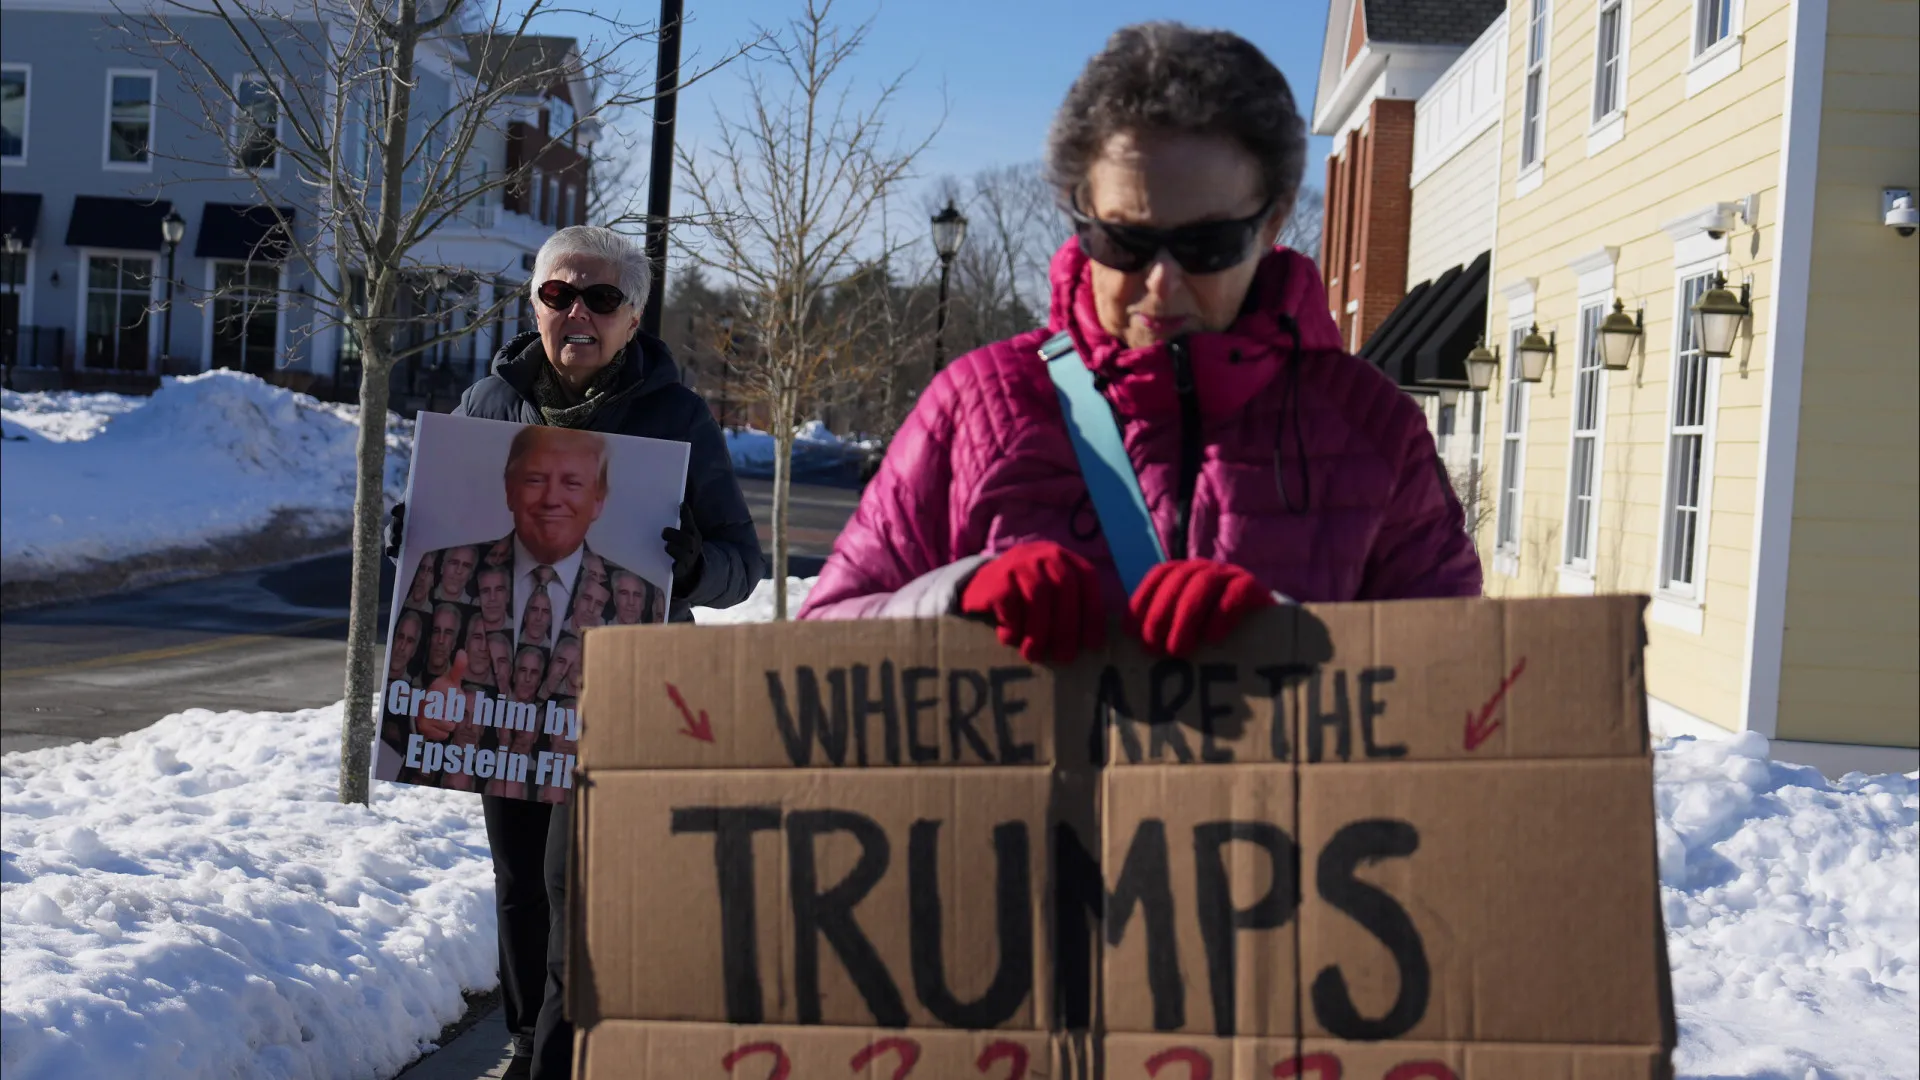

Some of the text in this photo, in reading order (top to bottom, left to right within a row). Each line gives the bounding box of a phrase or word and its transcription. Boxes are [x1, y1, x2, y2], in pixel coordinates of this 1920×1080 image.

[388, 680, 579, 741] Grab him by
[766, 660, 1408, 768] WHERE ARE THE
[406, 734, 528, 783] Epstein
[671, 806, 1431, 1042] TRUMPS
